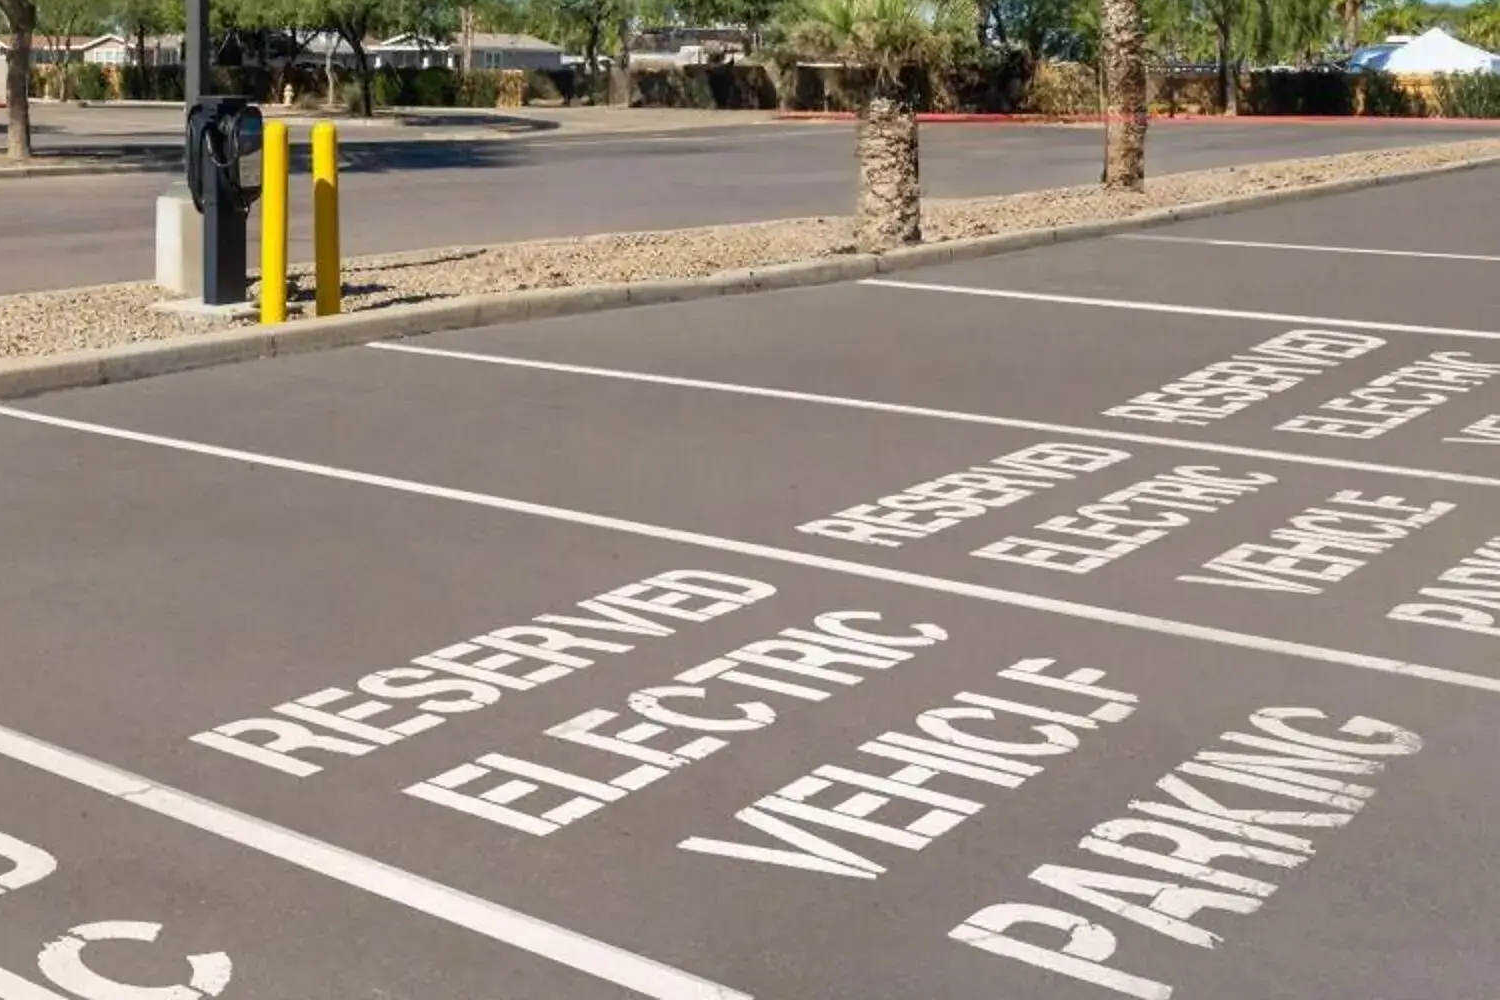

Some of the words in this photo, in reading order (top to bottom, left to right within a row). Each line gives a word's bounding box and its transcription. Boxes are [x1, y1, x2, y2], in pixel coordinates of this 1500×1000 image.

[1101, 329, 1387, 426] RESERVED
[1272, 351, 1500, 439] ELECTRIC
[794, 442, 1133, 547] RESERVED
[968, 465, 1279, 574] ELECTRIC
[1175, 489, 1458, 595] VEHICLE
[188, 569, 778, 777] RESERVED
[401, 610, 950, 837] ELECTRIC
[676, 657, 1140, 880] VEHICLE
[947, 707, 1423, 1000] PARKING
